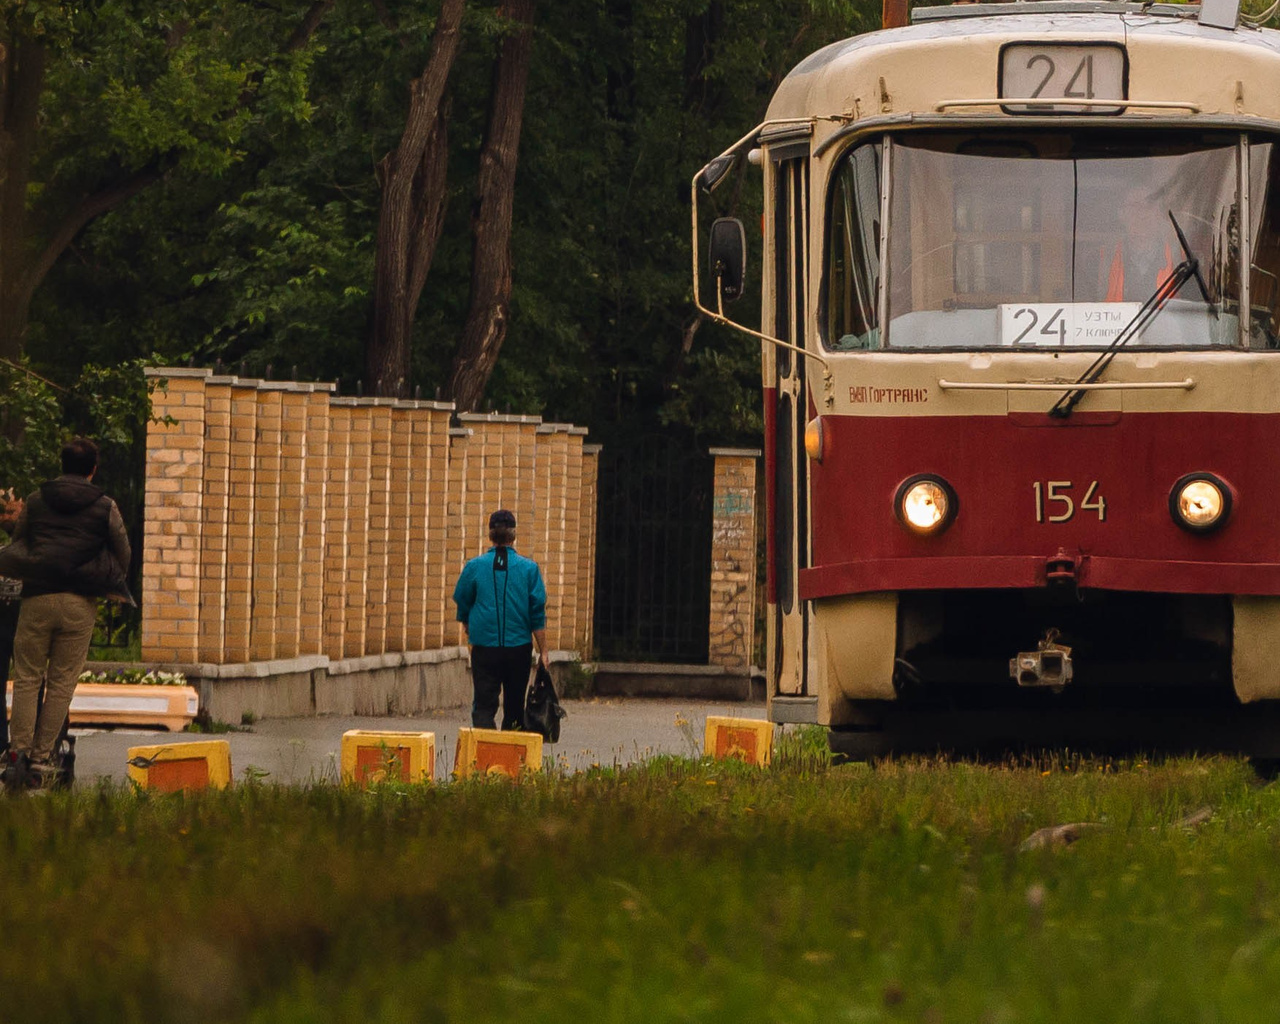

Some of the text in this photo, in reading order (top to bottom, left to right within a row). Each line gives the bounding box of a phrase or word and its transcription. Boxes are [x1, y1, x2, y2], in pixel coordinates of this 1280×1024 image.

[1026, 54, 1095, 112] 24
[1013, 308, 1067, 346] 24
[1075, 327, 1131, 338] 7 КЛЮЧЕ
[1084, 311, 1122, 322] УЗТМ
[1033, 480, 1107, 524] 154
